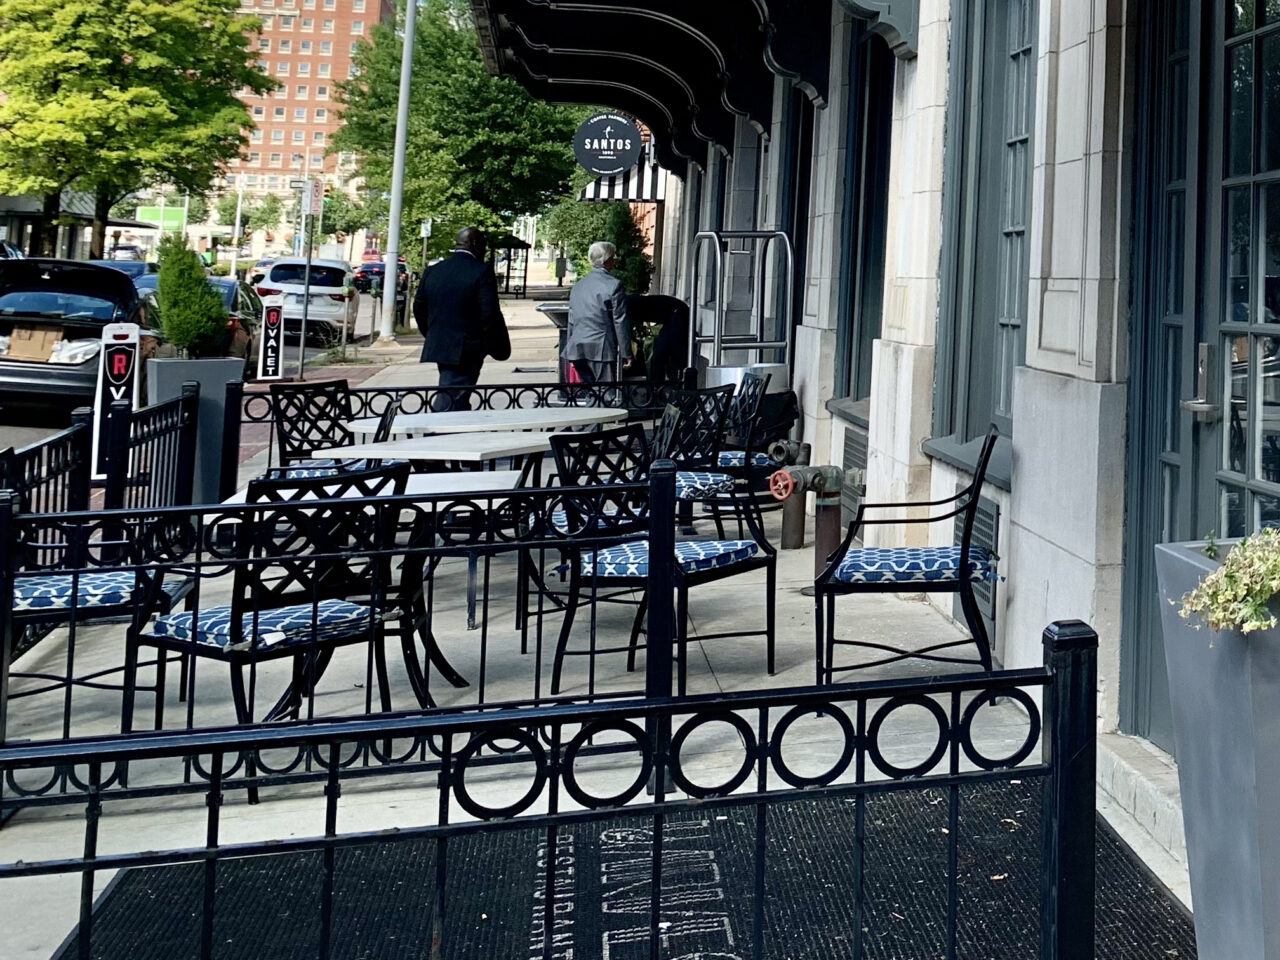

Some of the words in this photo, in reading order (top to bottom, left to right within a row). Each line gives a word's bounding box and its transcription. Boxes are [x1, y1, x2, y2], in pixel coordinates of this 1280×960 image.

[584, 138, 632, 150] SANTOS
[266, 328, 278, 376] VALET
[112, 353, 127, 376] R
